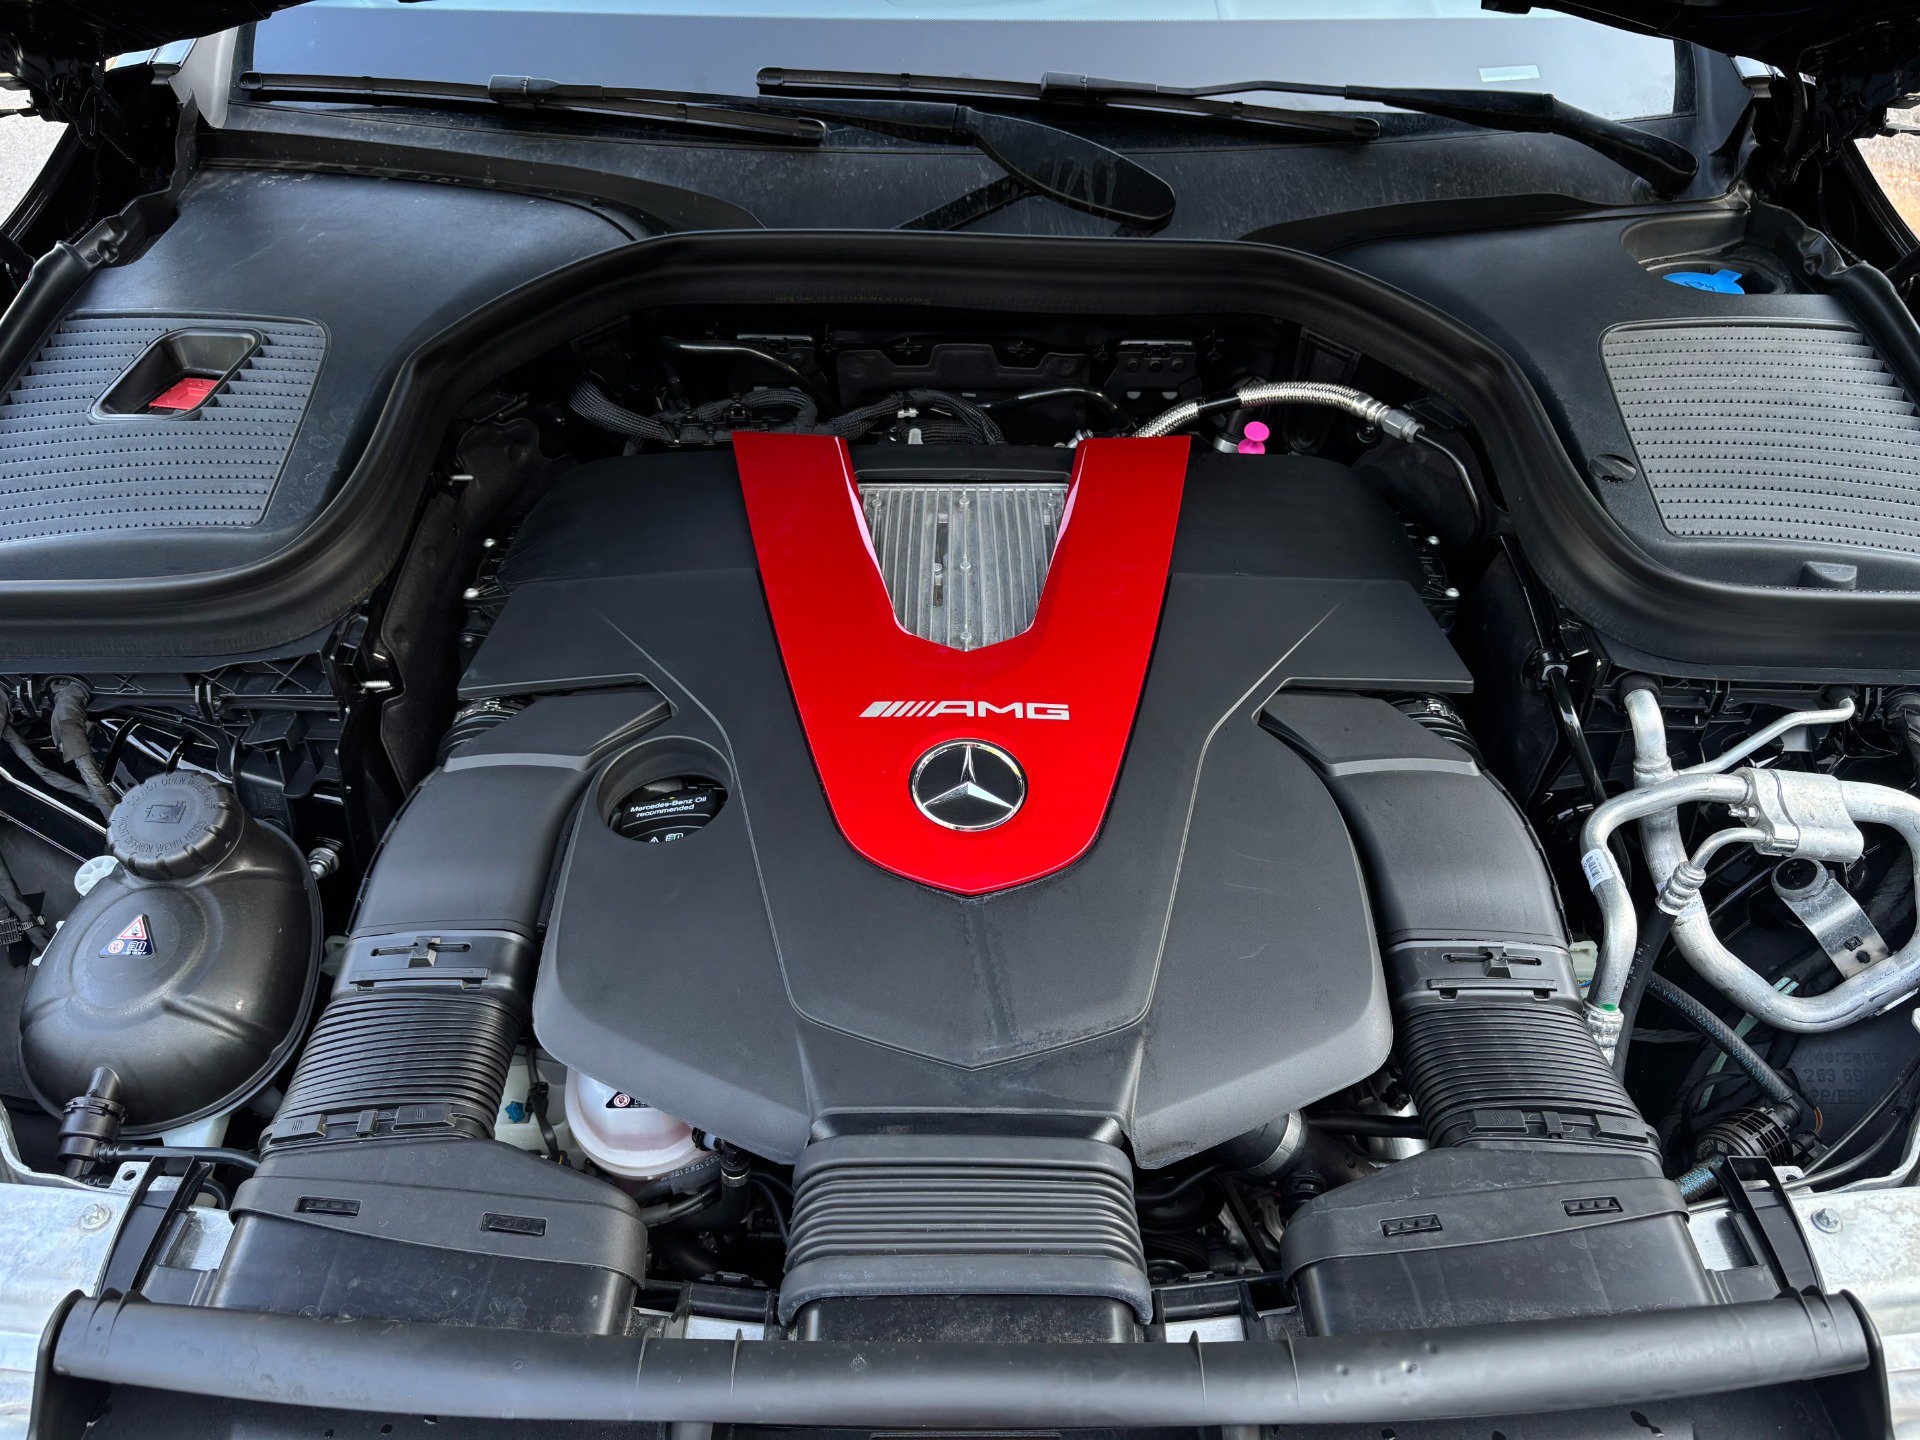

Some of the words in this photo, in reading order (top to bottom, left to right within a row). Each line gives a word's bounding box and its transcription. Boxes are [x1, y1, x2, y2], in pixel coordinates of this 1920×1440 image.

[926, 700, 1070, 721] AMG
[630, 797, 694, 813] Mercedes-Benz
[695, 796, 707, 804] Oil
[636, 803, 695, 818] recommended
[155, 837, 182, 853] WENN
